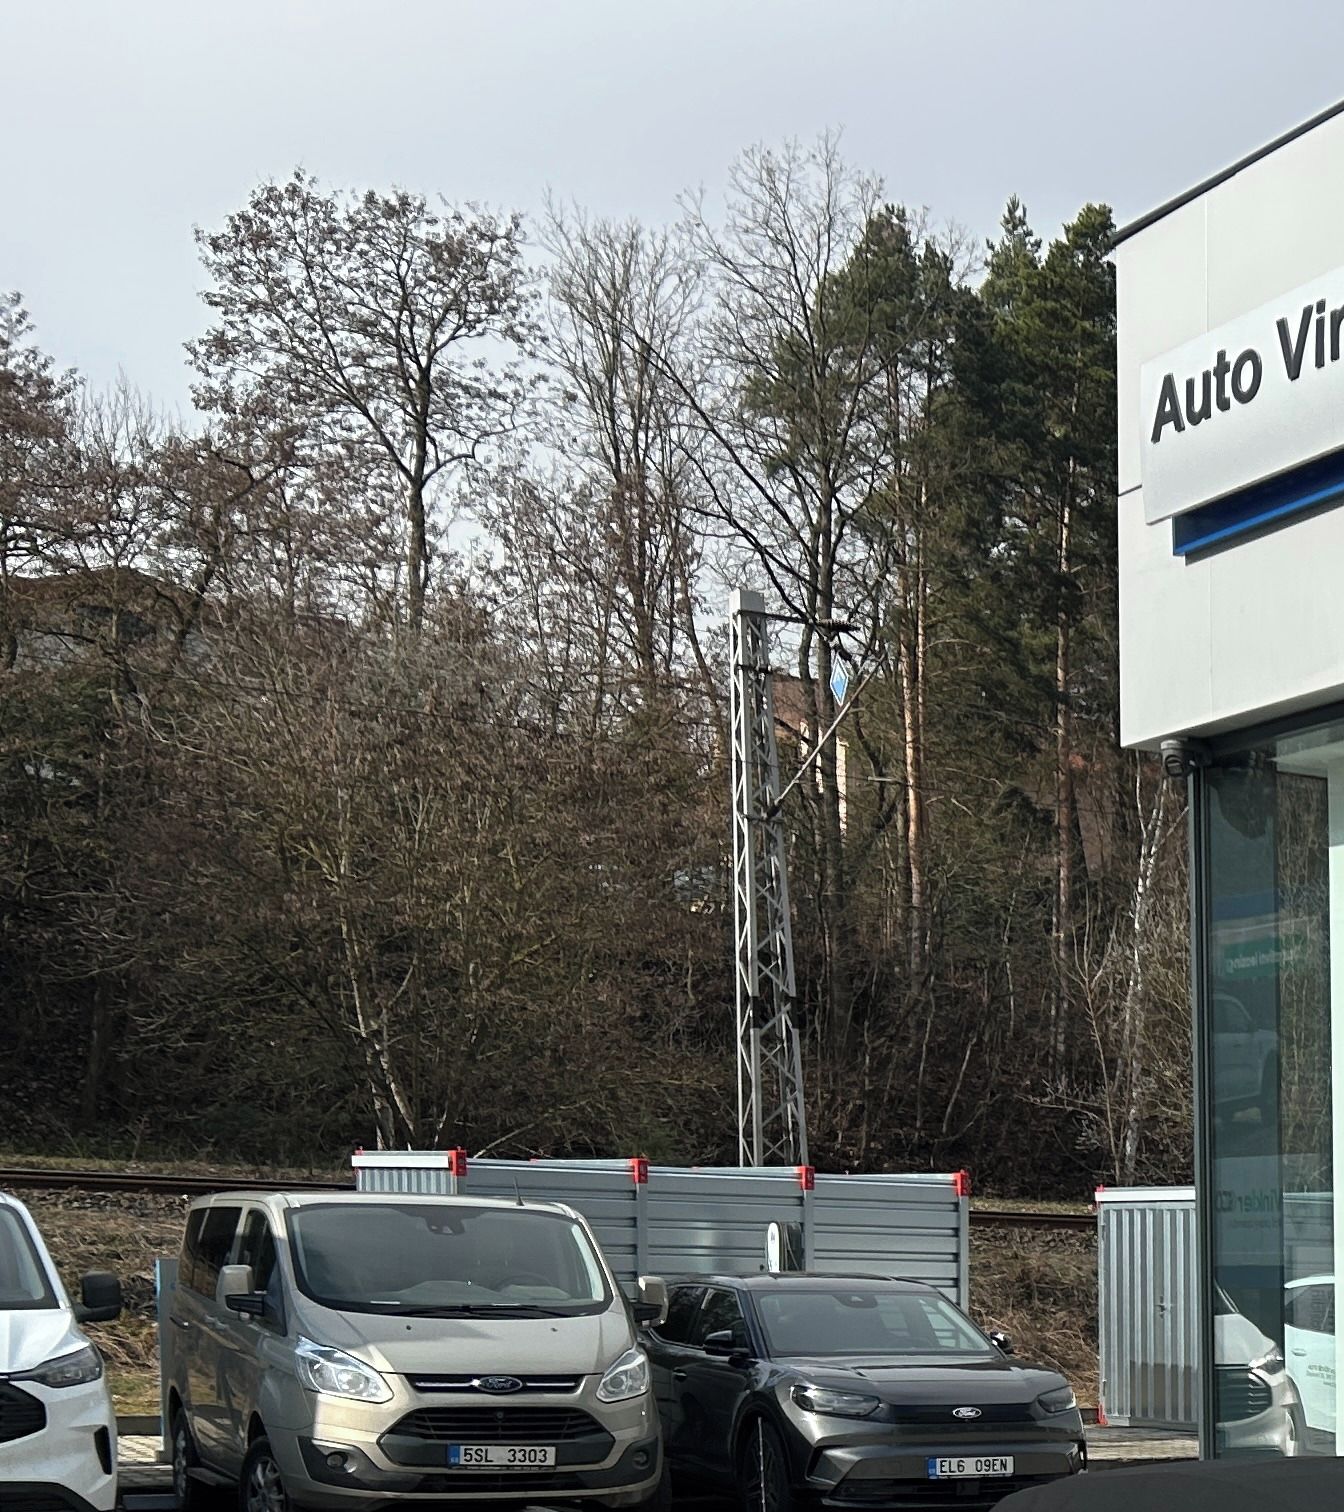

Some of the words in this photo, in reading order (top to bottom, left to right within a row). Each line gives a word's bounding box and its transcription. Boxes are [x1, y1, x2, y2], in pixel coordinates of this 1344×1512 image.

[1150, 347, 1263, 444] Auto
[463, 1447, 494, 1463] 5SL
[507, 1448, 548, 1463] 3303
[939, 1460, 966, 1474] EL6
